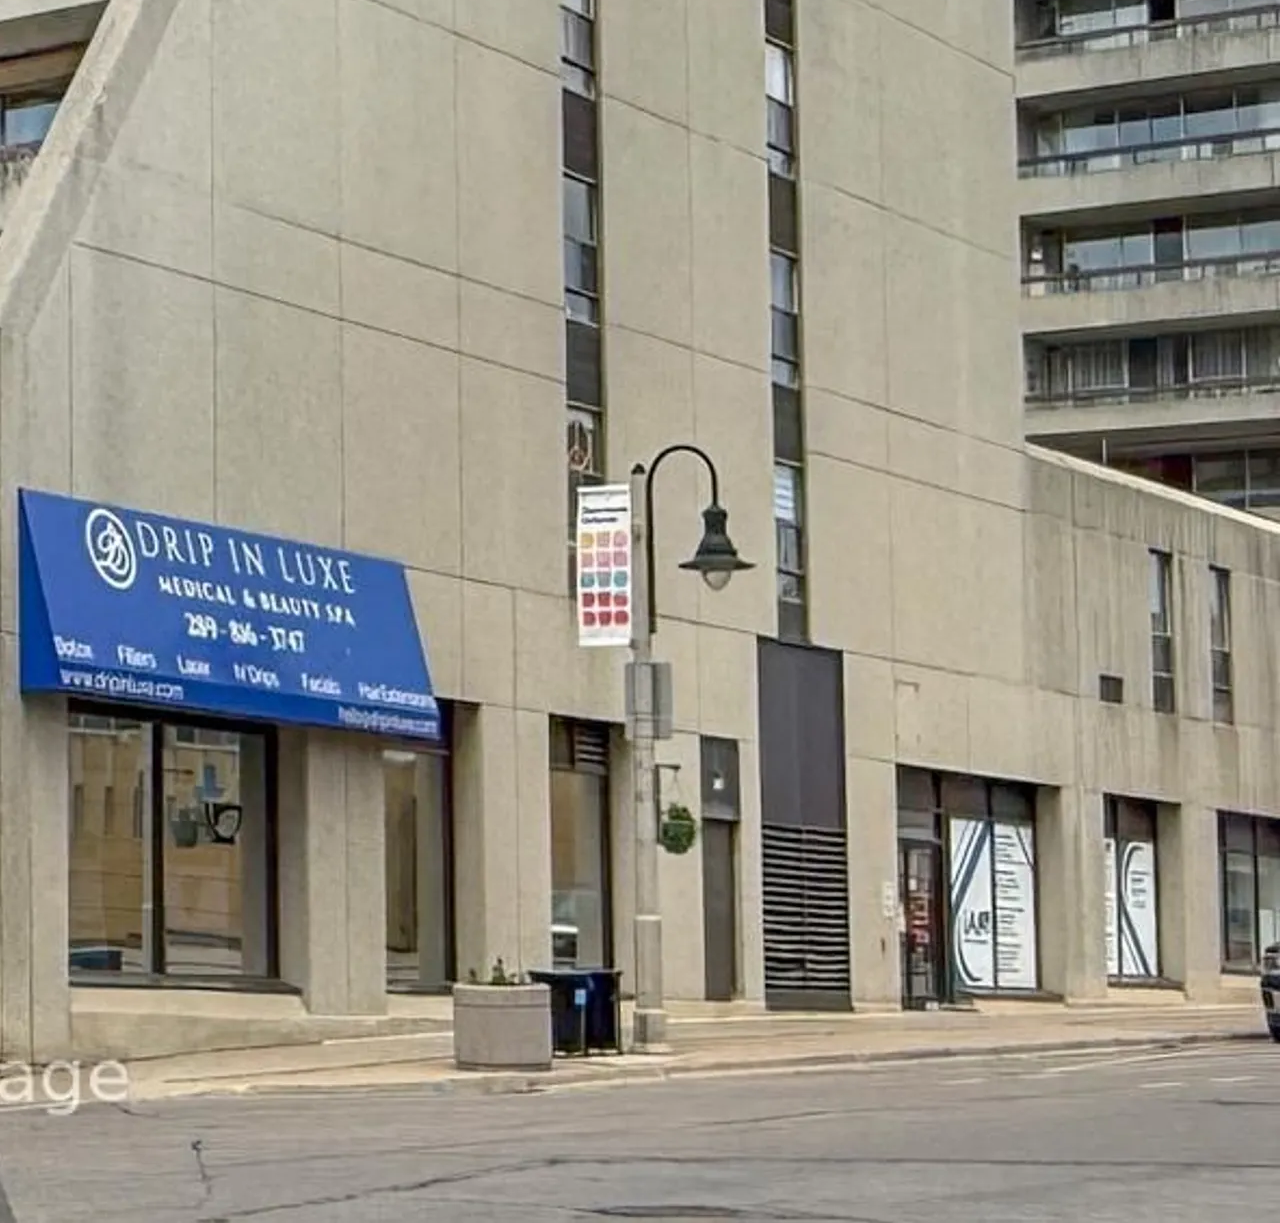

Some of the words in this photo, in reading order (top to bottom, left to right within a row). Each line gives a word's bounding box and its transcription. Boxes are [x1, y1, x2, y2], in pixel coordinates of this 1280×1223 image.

[137, 521, 214, 566] DRIP
[228, 538, 265, 577] IN
[278, 546, 356, 594] LUXE
[158, 576, 236, 606] MEDICAL
[260, 591, 321, 620] BEAUTY
[325, 604, 356, 626] SPA
